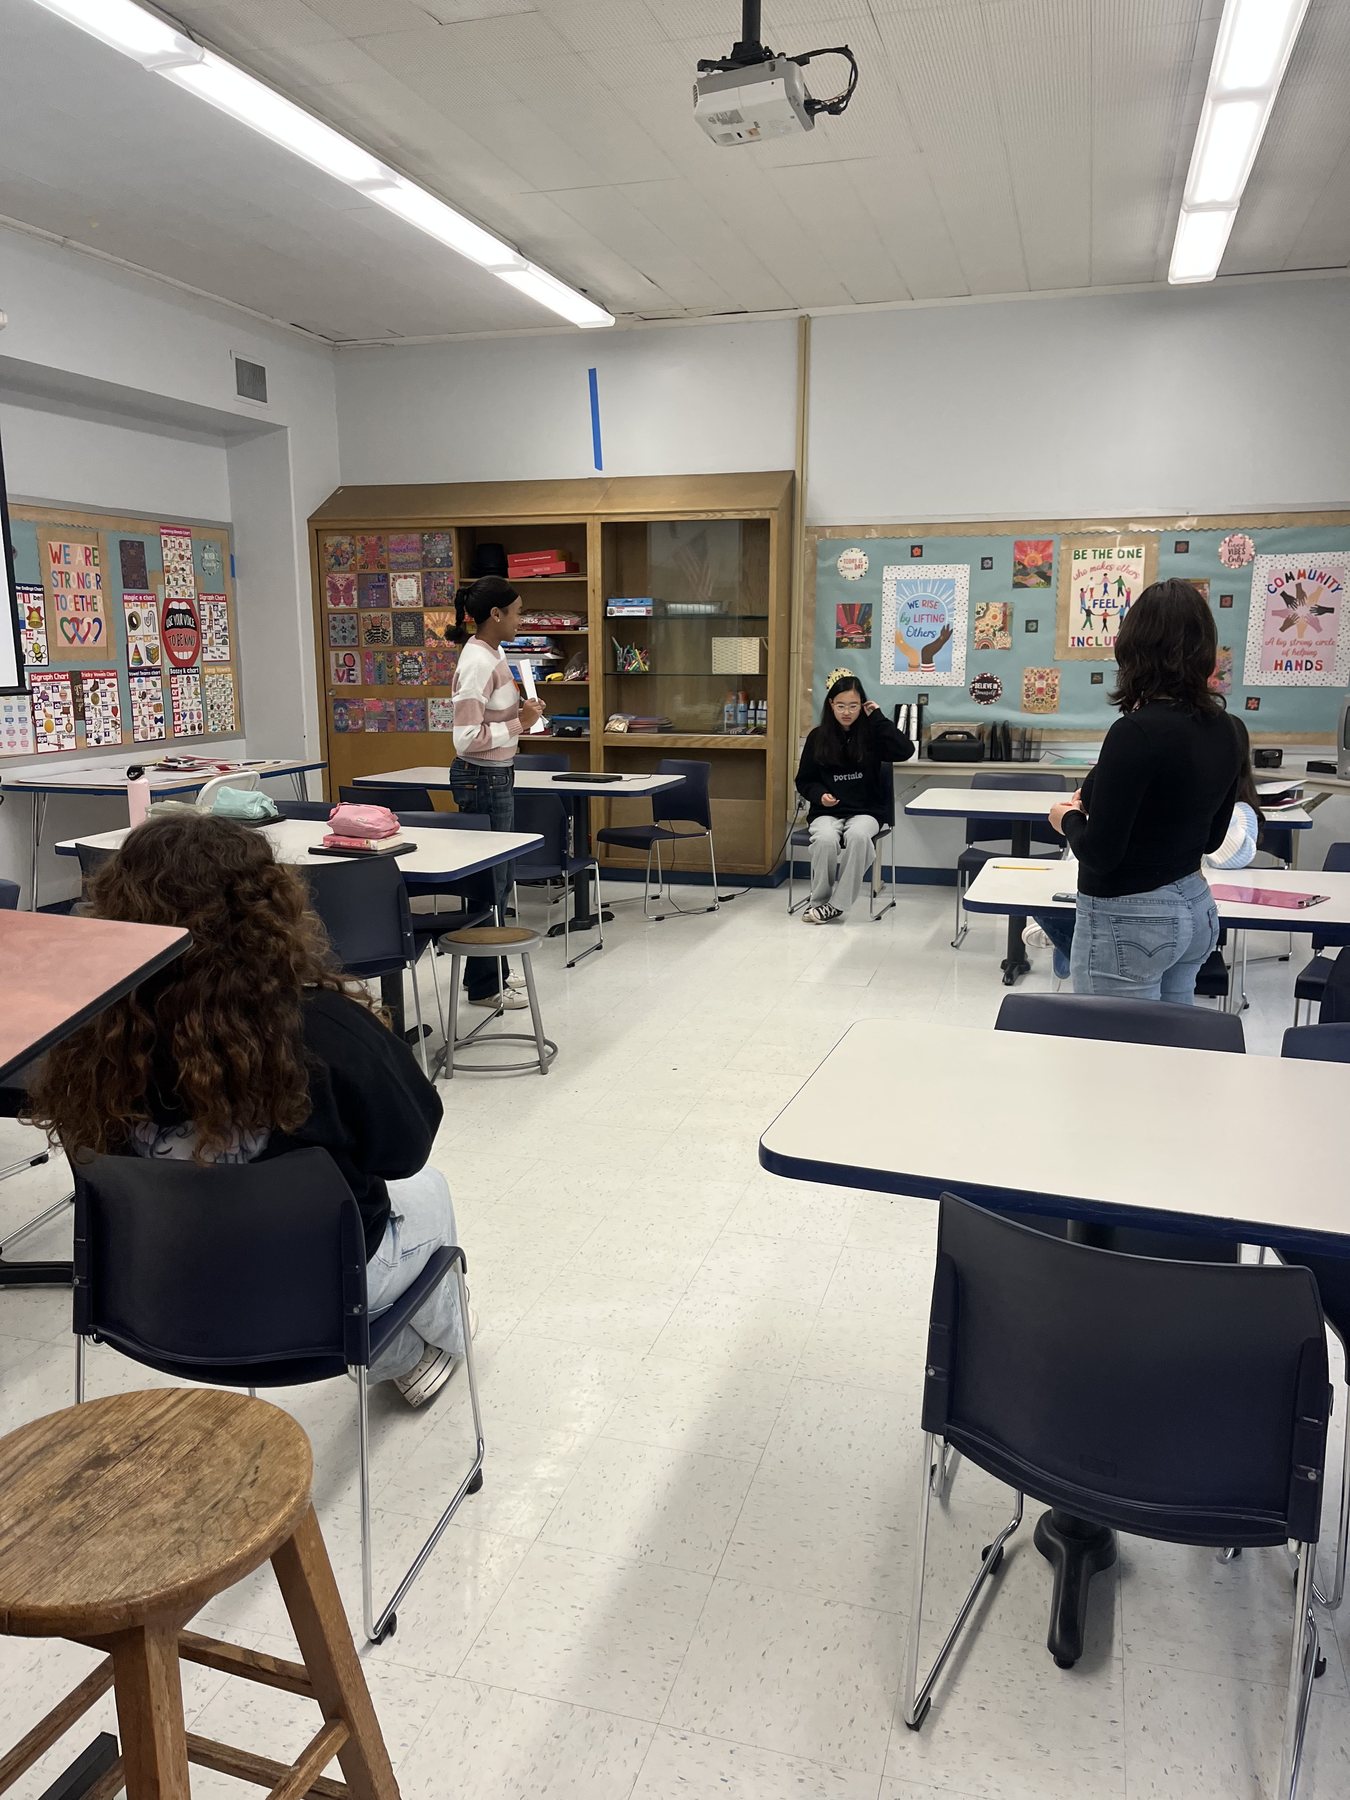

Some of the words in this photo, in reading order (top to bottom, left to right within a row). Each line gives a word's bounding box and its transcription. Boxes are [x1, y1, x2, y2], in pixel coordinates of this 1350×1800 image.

[49, 543, 71, 565] WE
[76, 547, 100, 567] ARE
[1073, 549, 1088, 561] BE
[1092, 549, 1113, 560] THE
[1117, 548, 1142, 559] ONE
[1073, 569, 1088, 581] who
[1089, 561, 1113, 573] makes
[1116, 564, 1140, 580] others
[51, 570, 102, 590] STRONGER
[1266, 568, 1343, 594] COMMUNITY
[54, 594, 104, 613] TOGETHER
[907, 599, 920, 610] WE
[921, 599, 939, 610] RISE
[1093, 599, 1118, 608] FEEL
[900, 611, 911, 626] by
[913, 613, 945, 624] LIFTING
[906, 625, 937, 639] Others
[168, 634, 177, 646] TO
[176, 633, 183, 646] BE
[184, 634, 197, 647] KIND
[1071, 636, 1118, 647] INCLU
[1265, 637, 1274, 646] A
[1289, 638, 1313, 648] strong
[1315, 638, 1336, 646] circle
[1281, 649, 1290, 658] of
[1291, 648, 1317, 657] helping
[1274, 660, 1323, 671] HANDS
